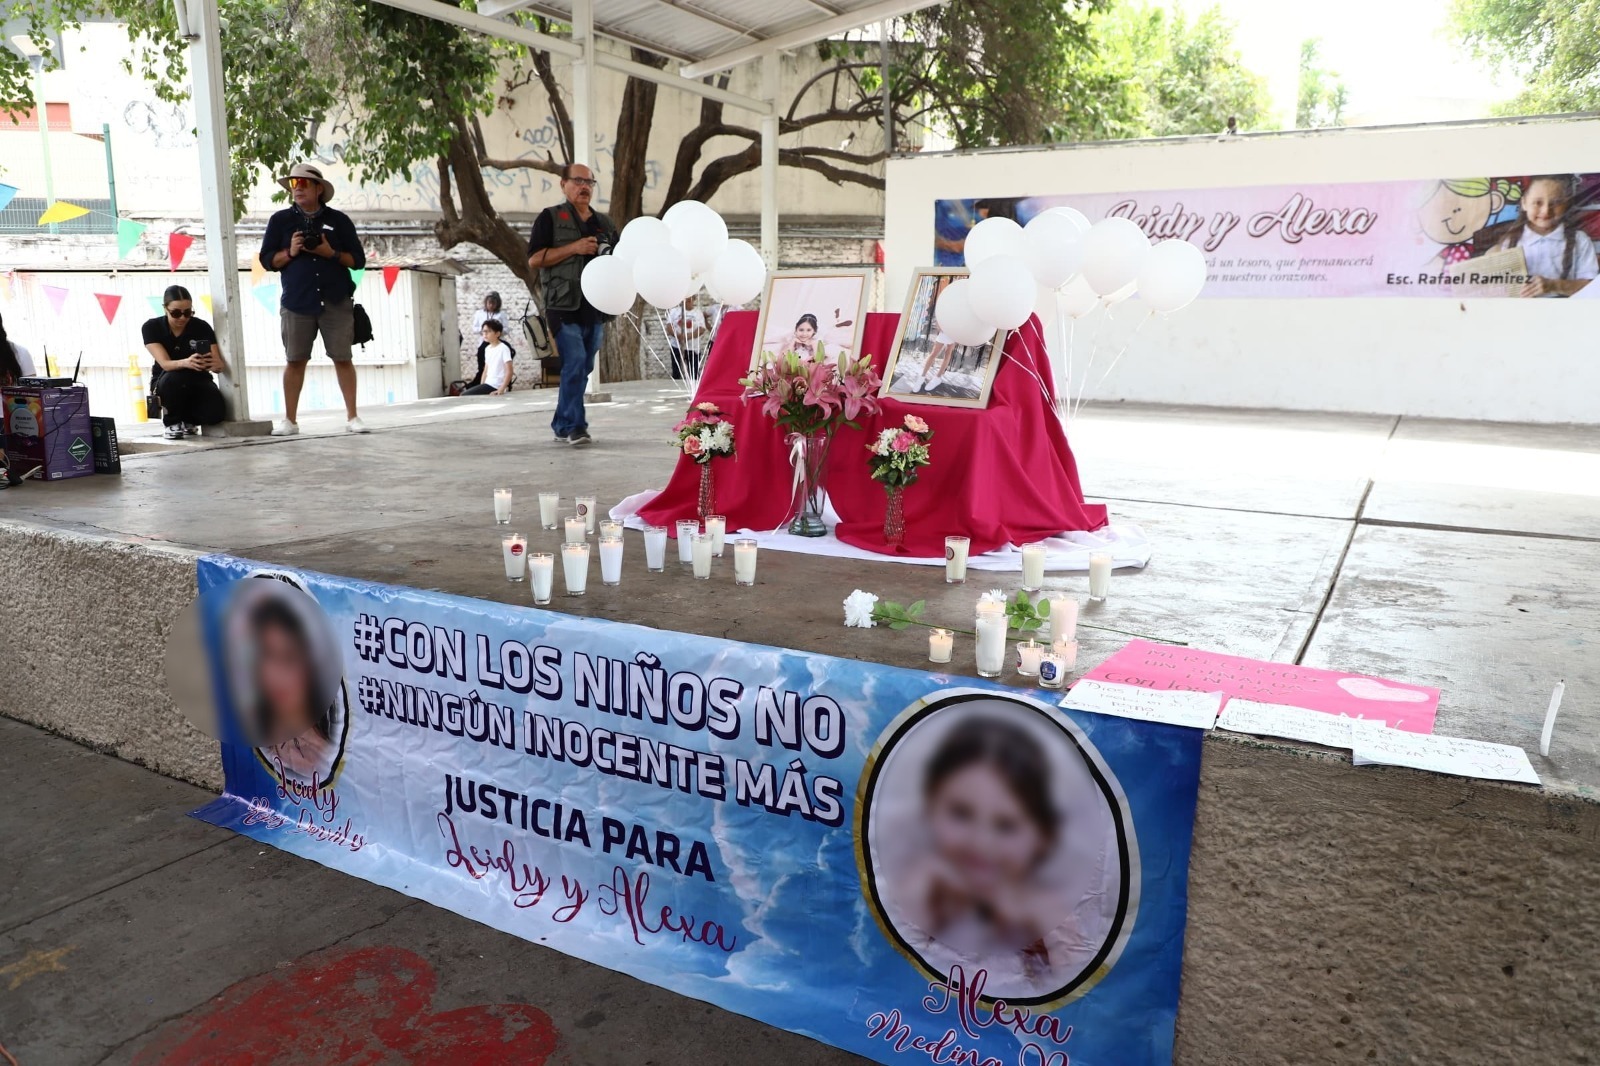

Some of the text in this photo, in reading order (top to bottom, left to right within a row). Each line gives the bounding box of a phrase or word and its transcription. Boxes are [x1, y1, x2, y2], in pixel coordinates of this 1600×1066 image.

[1204, 211, 1240, 252] y
[1246, 192, 1378, 244] Alexa
[1219, 260, 1234, 268] un
[1237, 258, 1272, 269] tesoro,
[1276, 258, 1297, 274] que
[1298, 255, 1374, 273] permanecerá
[1221, 272, 1267, 282] nuestros
[1269, 271, 1328, 283] corazones.
[1386, 272, 1414, 285] Esc.
[1418, 272, 1466, 285] Rafael
[353, 613, 846, 759] #CON LOS NIÑOS NO
[358, 675, 845, 828] #NINGÚN INOCENTE MÁS
[274, 756, 340, 822] Leidy
[444, 774, 715, 883] JUSTICIA PARA
[437, 812, 736, 951] Leidy y Alexa
[866, 1008, 1003, 1066] Medina
[922, 964, 1073, 1044] Alexa
